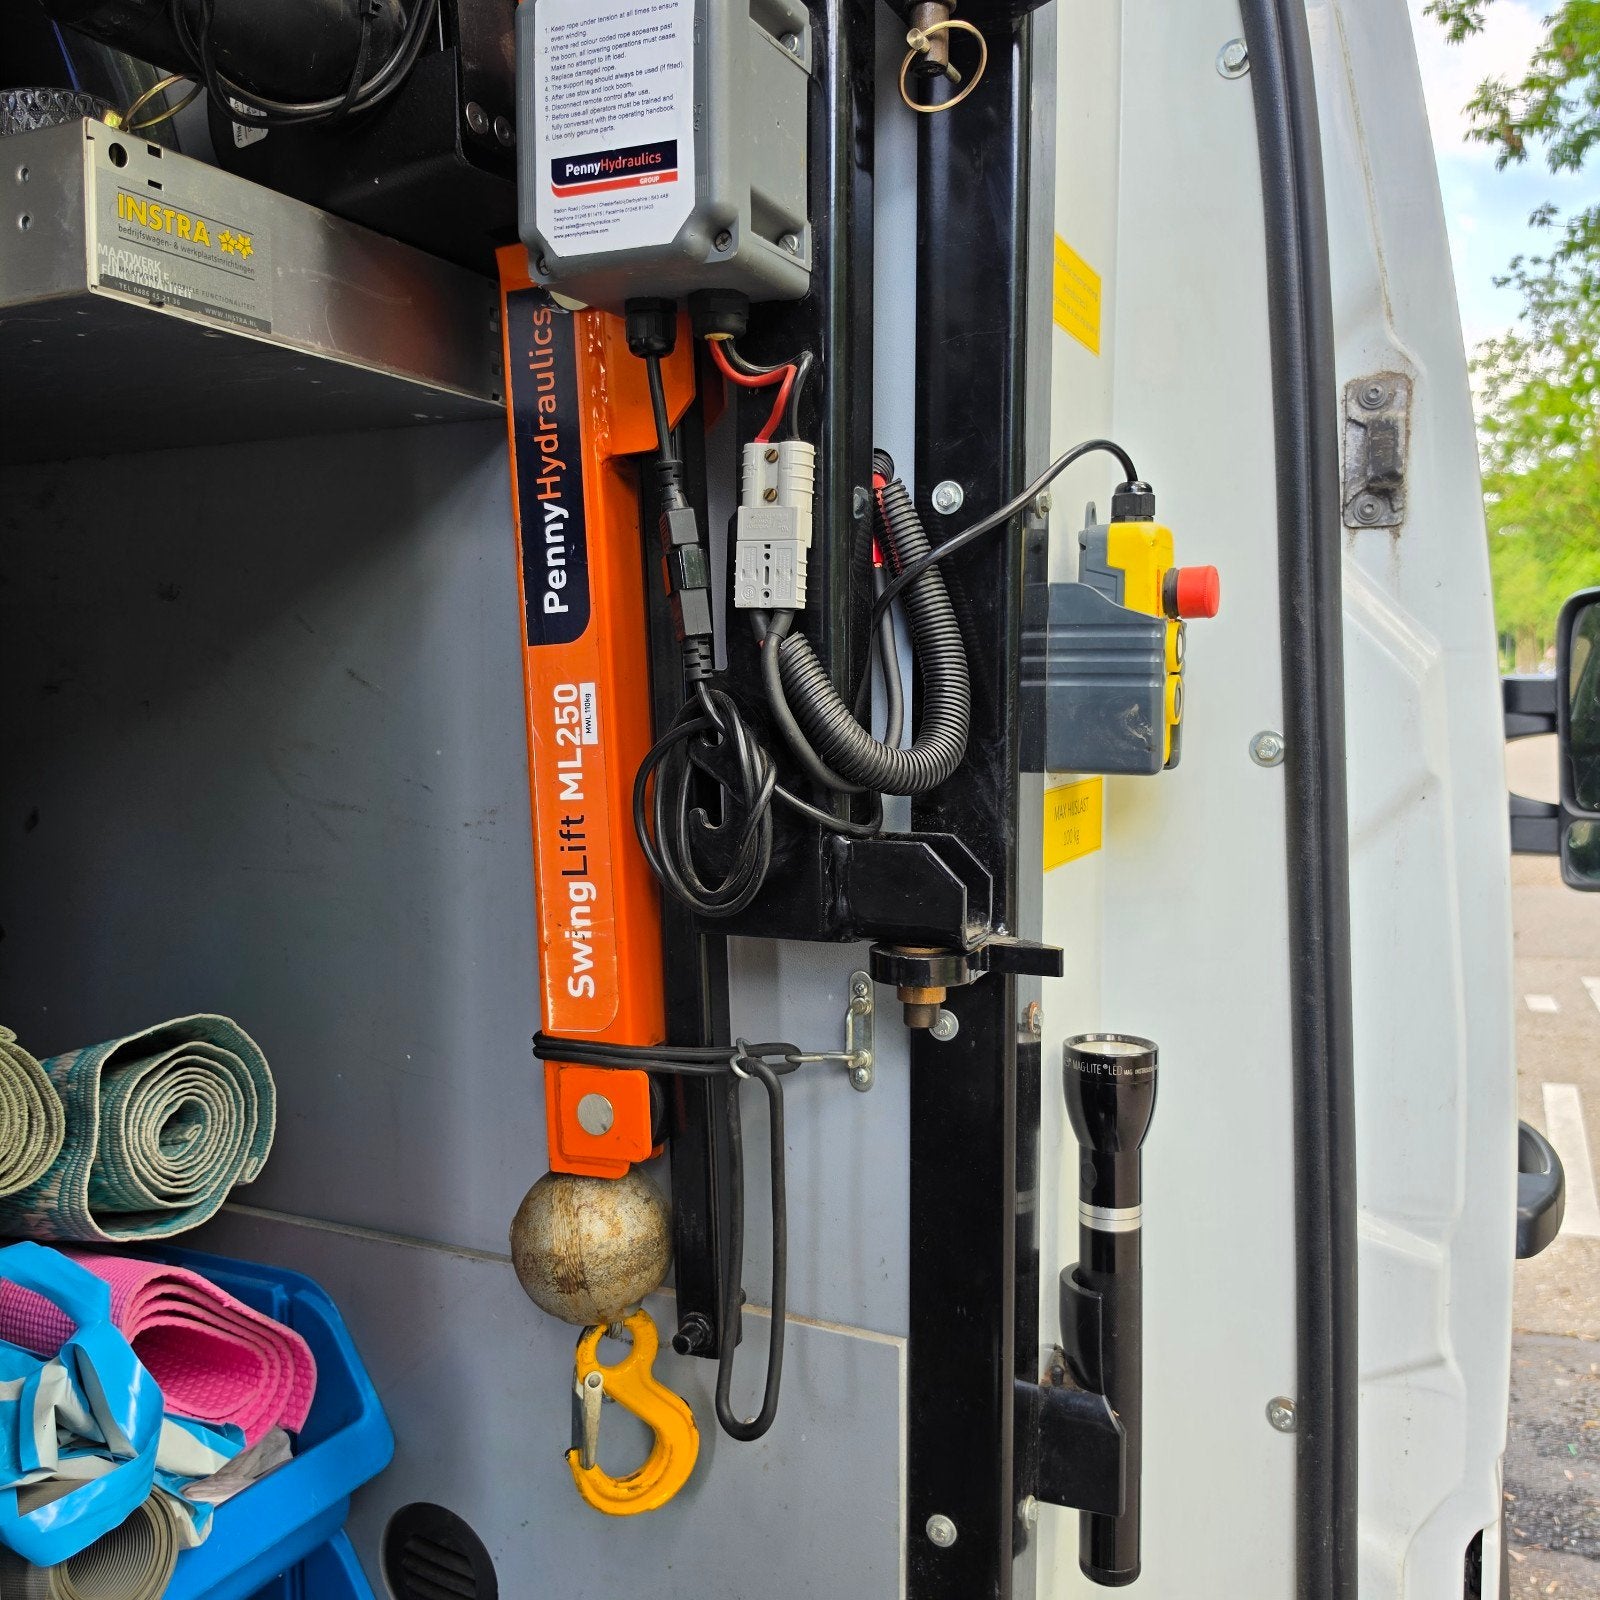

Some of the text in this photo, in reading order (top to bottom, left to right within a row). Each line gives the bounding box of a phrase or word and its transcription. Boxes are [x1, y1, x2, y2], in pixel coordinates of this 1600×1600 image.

[580, 18, 596, 26] under
[598, 14, 618, 22] tension
[659, 2, 678, 10] ensure
[599, 33, 616, 43] coded
[660, 22, 672, 32] past
[587, 45, 610, 55] lowering
[612, 40, 641, 51] operations
[643, 35, 657, 44] must
[552, 63, 565, 71] Make
[576, 57, 596, 67] attempt
[613, 52, 626, 60] load.
[552, 72, 573, 81] Replace
[575, 66, 600, 76] damaged
[564, 79, 583, 89] support
[595, 74, 613, 83] should
[615, 72, 634, 80] always
[645, 66, 658, 75] used
[667, 62, 683, 71] fitted).
[603, 84, 614, 92] lock
[552, 100, 582, 111] Disconnect
[583, 96, 602, 105] remote
[604, 93, 622, 102] control
[590, 105, 616, 115] operators
[618, 101, 631, 109] must
[642, 96, 661, 105] trained
[564, 117, 593, 128] conversant
[618, 110, 644, 120] operating
[577, 128, 598, 138] genuine
[566, 152, 662, 177] PennyHydraulics
[640, 176, 660, 185] GROUP
[118, 192, 211, 247] INSTRA
[118, 224, 172, 248] bedrijfswagen-
[174, 242, 179, 250] &
[98, 243, 160, 270] MAATWERK
[119, 282, 130, 292] TEL
[528, 308, 569, 614] PennyHydraulics
[1054, 802, 1066, 821] MAX
[554, 682, 596, 998] SwingLift ML250
[1109, 1064, 1122, 1075] LED
